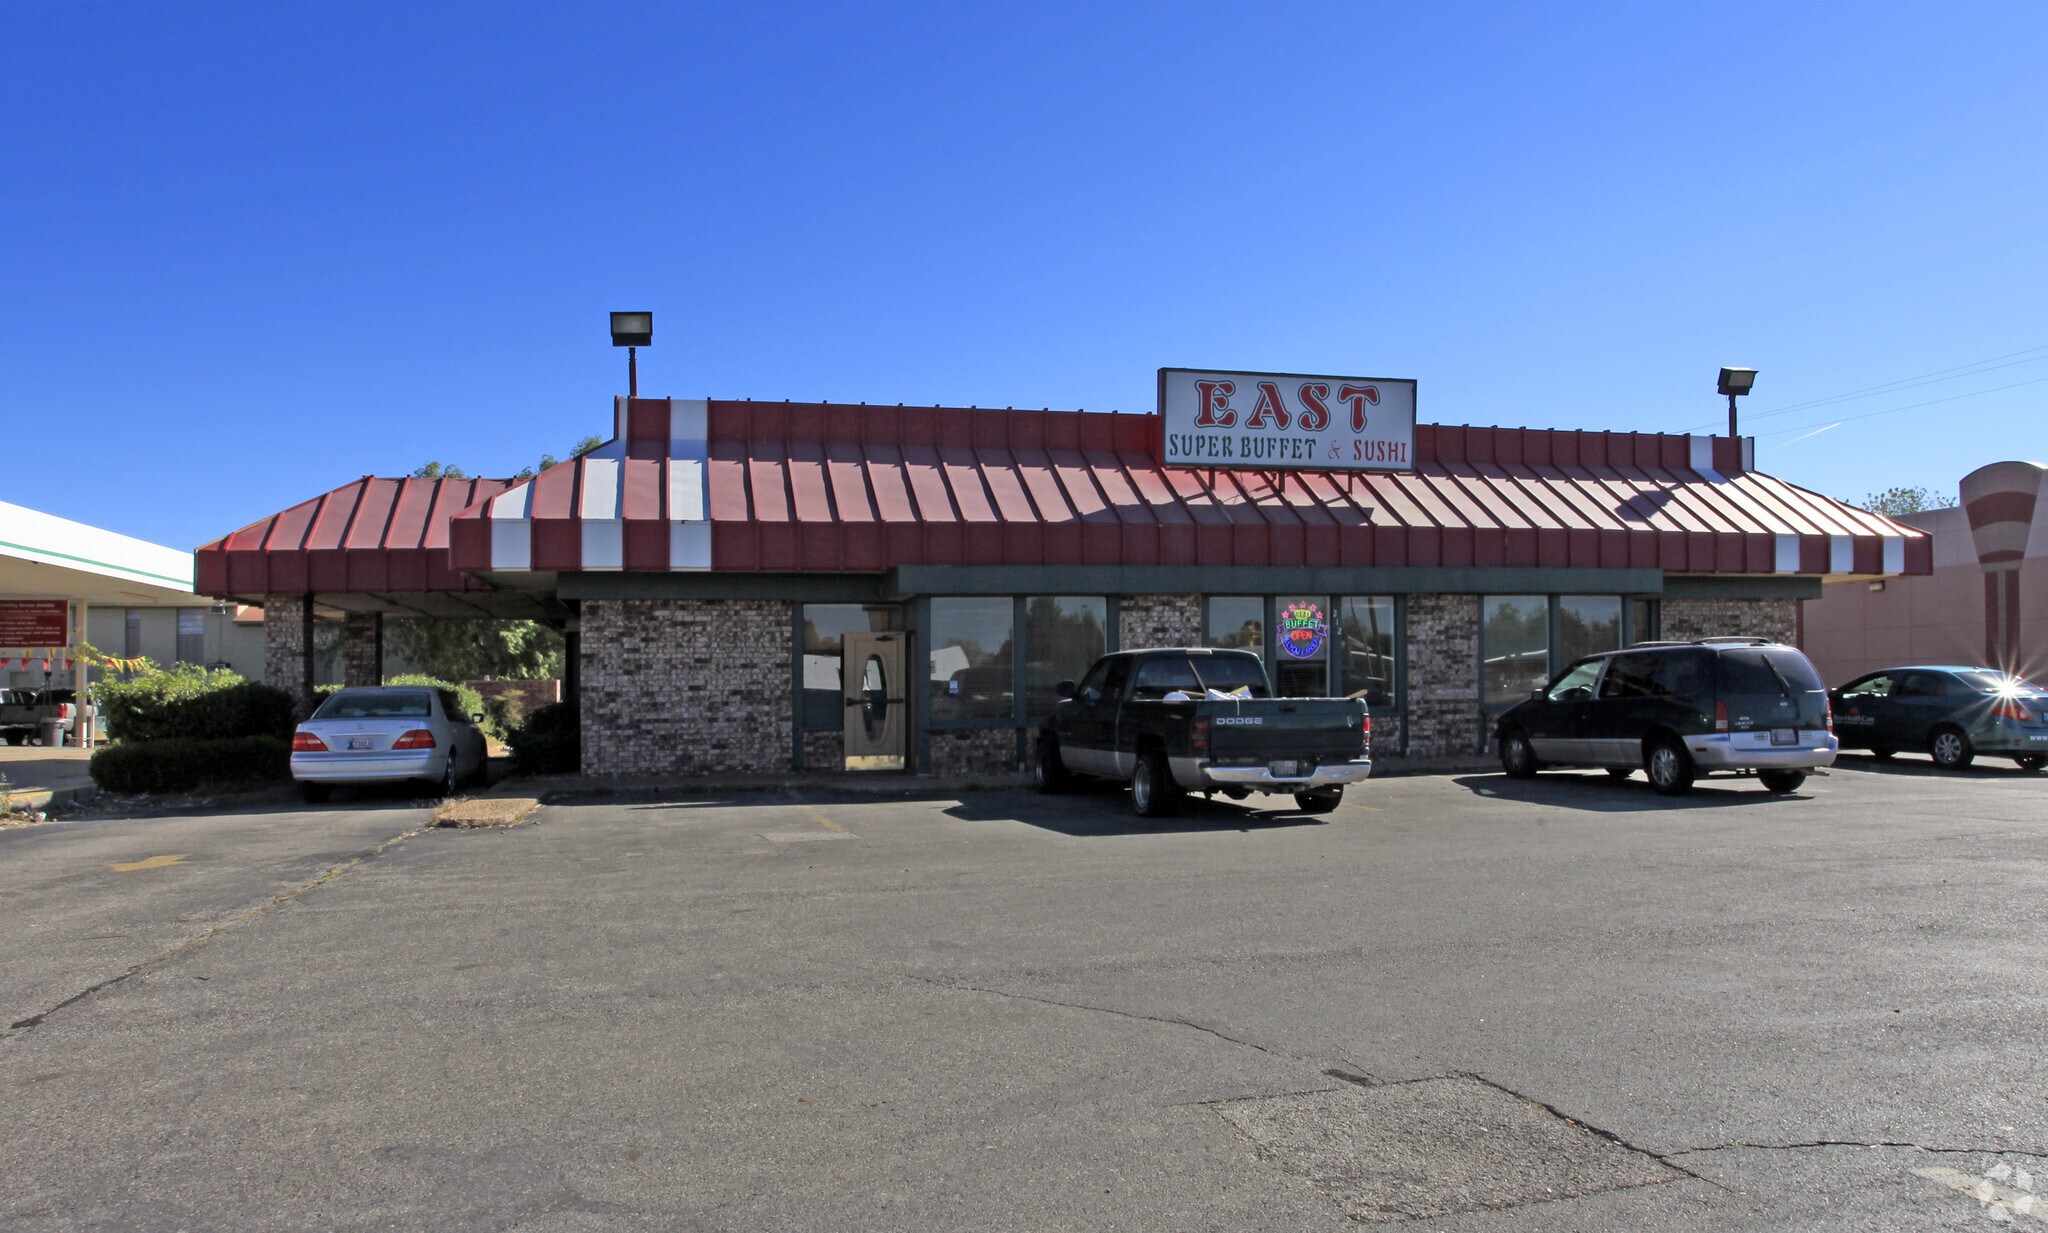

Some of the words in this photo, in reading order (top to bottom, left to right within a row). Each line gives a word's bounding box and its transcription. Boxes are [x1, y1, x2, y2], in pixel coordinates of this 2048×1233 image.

[1194, 379, 1380, 433] EAST
[1169, 433, 1234, 457] SUPER
[1240, 435, 1317, 460] BUFFET
[1327, 440, 1341, 460] &
[1353, 439, 1407, 463] SUSHI
[1285, 620, 1319, 628] BUFFET
[1291, 630, 1312, 641] OPEN
[1216, 717, 1262, 725] DODGE
